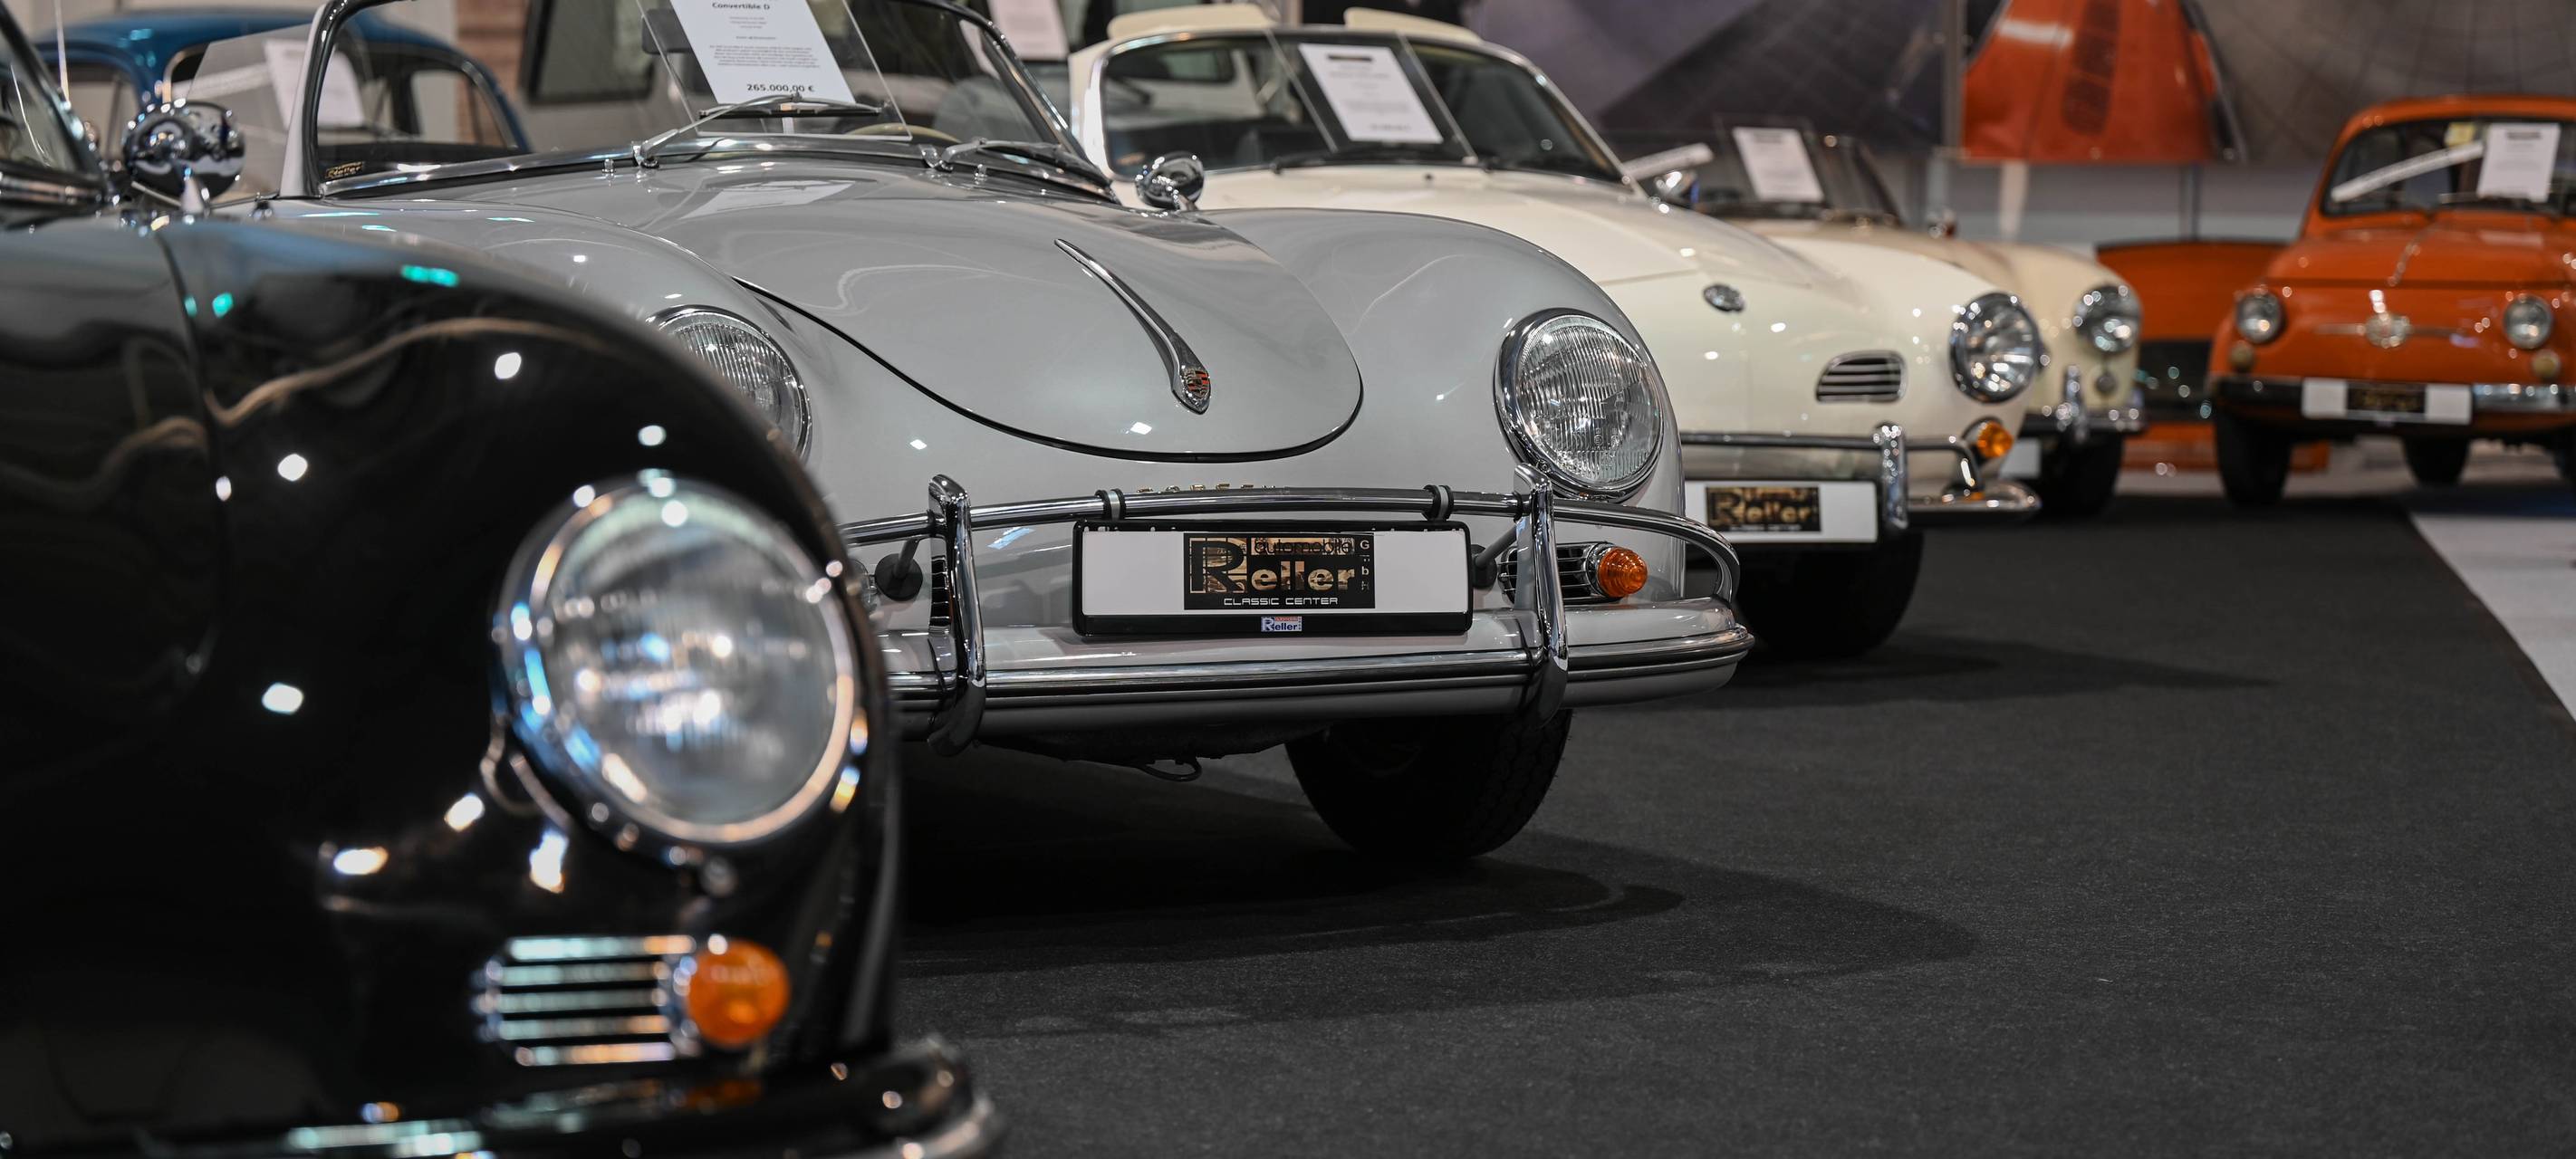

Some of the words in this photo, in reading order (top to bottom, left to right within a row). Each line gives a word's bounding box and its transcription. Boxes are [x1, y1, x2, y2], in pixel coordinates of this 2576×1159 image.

[712, 2, 761, 10] Convertible
[746, 83, 805, 92] 265.000,00
[1191, 539, 1355, 593] Reller
[1224, 598, 1280, 606] CLASSIC
[1285, 597, 1339, 605] CENTER
[1261, 618, 1297, 631] Reller
